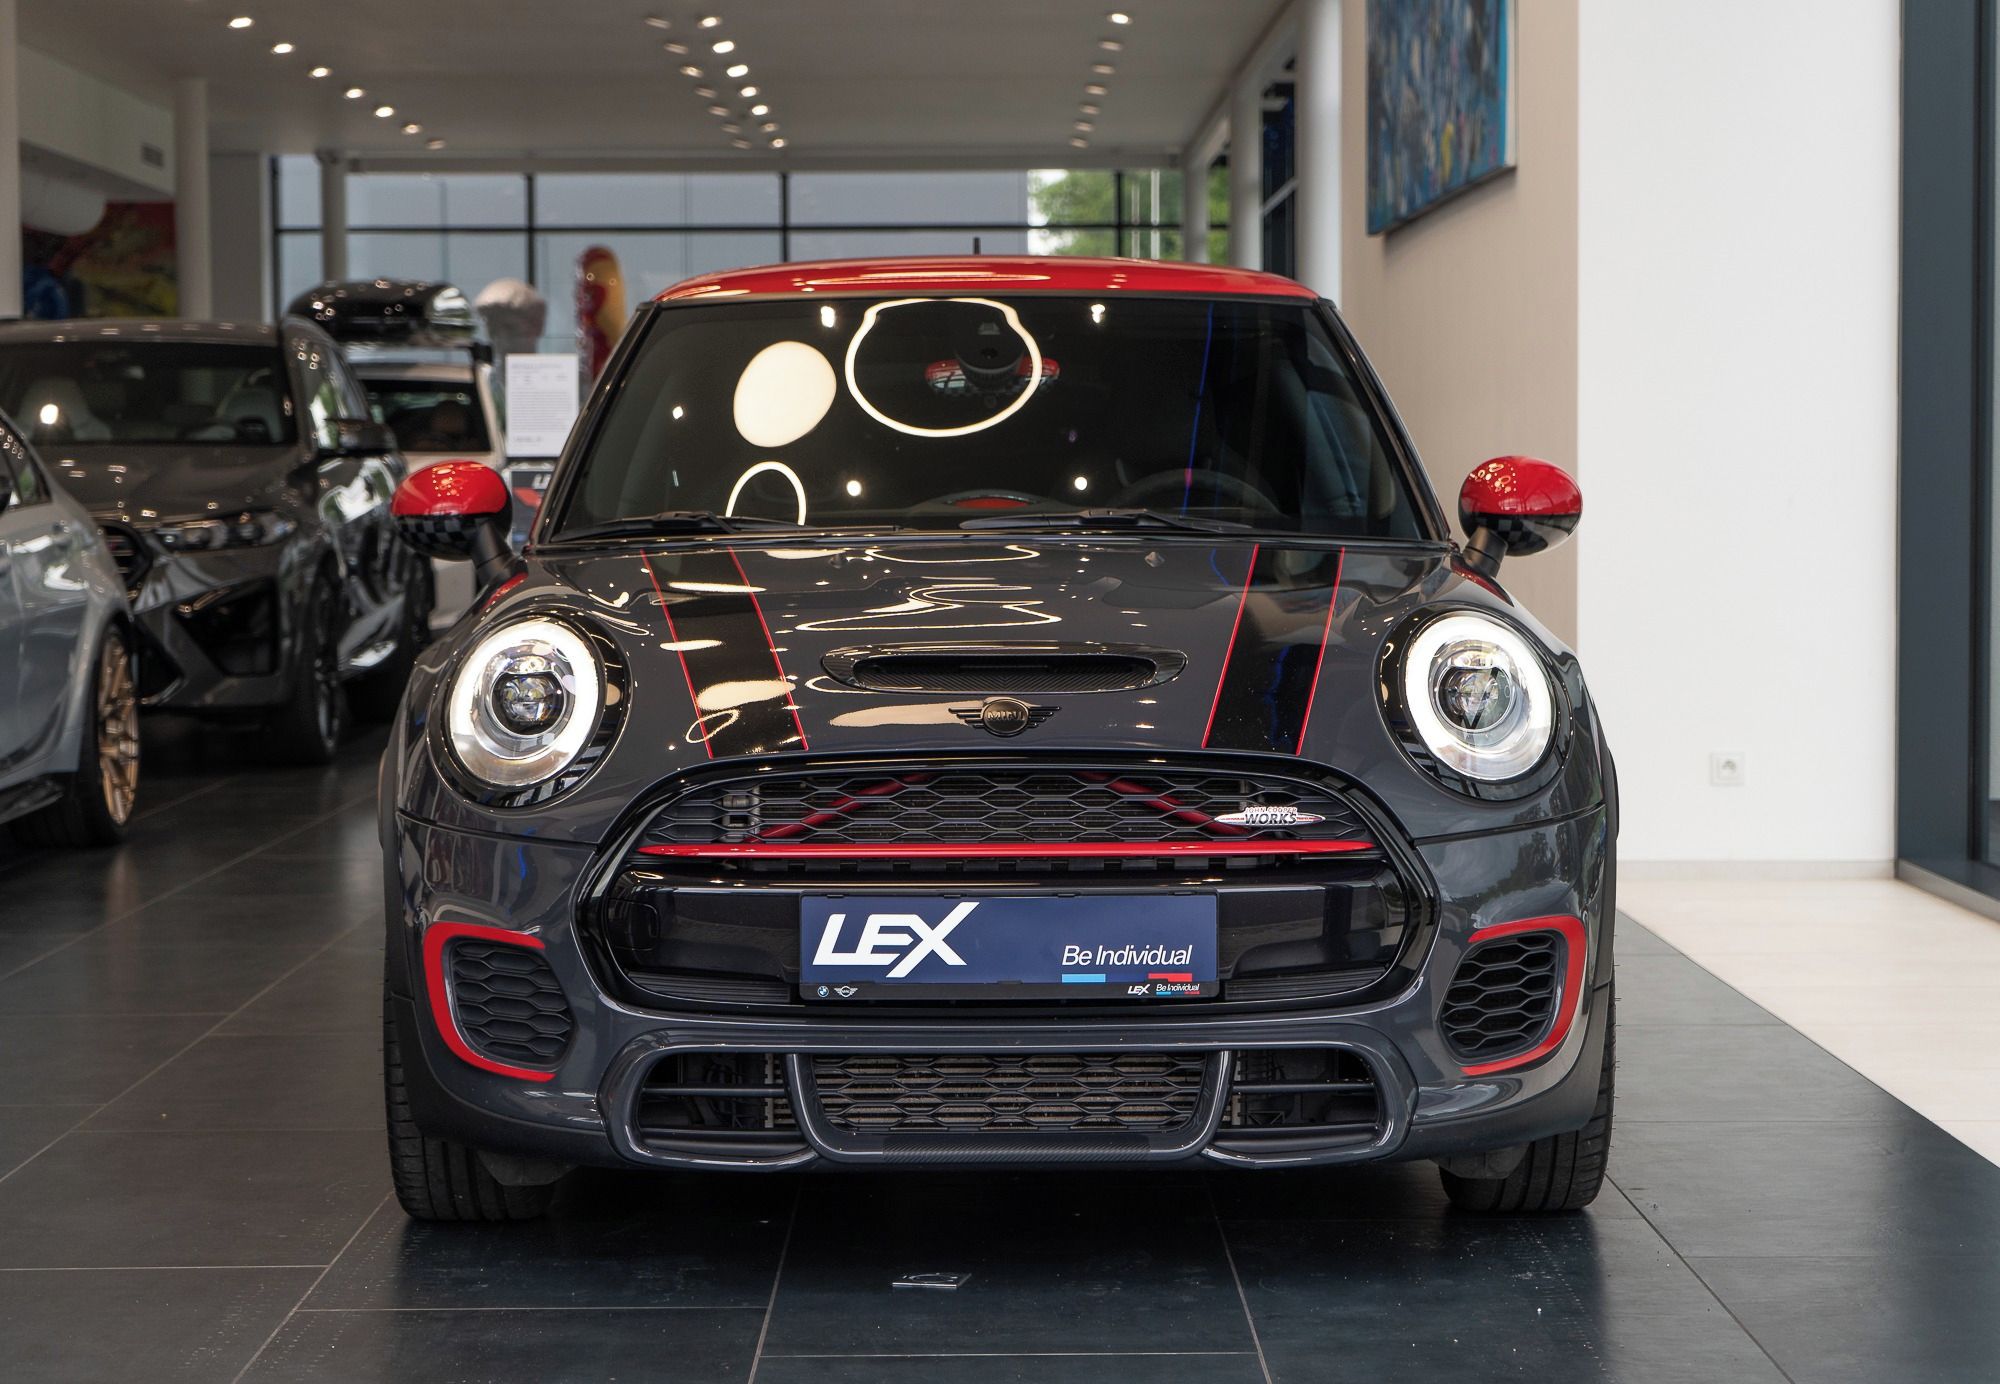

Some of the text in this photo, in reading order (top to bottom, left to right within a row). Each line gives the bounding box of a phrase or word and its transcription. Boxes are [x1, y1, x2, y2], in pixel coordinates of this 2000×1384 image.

[1245, 813, 1297, 825] WORKS
[813, 902, 980, 978] LEX
[1062, 944, 1193, 966] Be Individual
[1128, 984, 1150, 995] LEX
[1156, 983, 1200, 992] Be Individual
